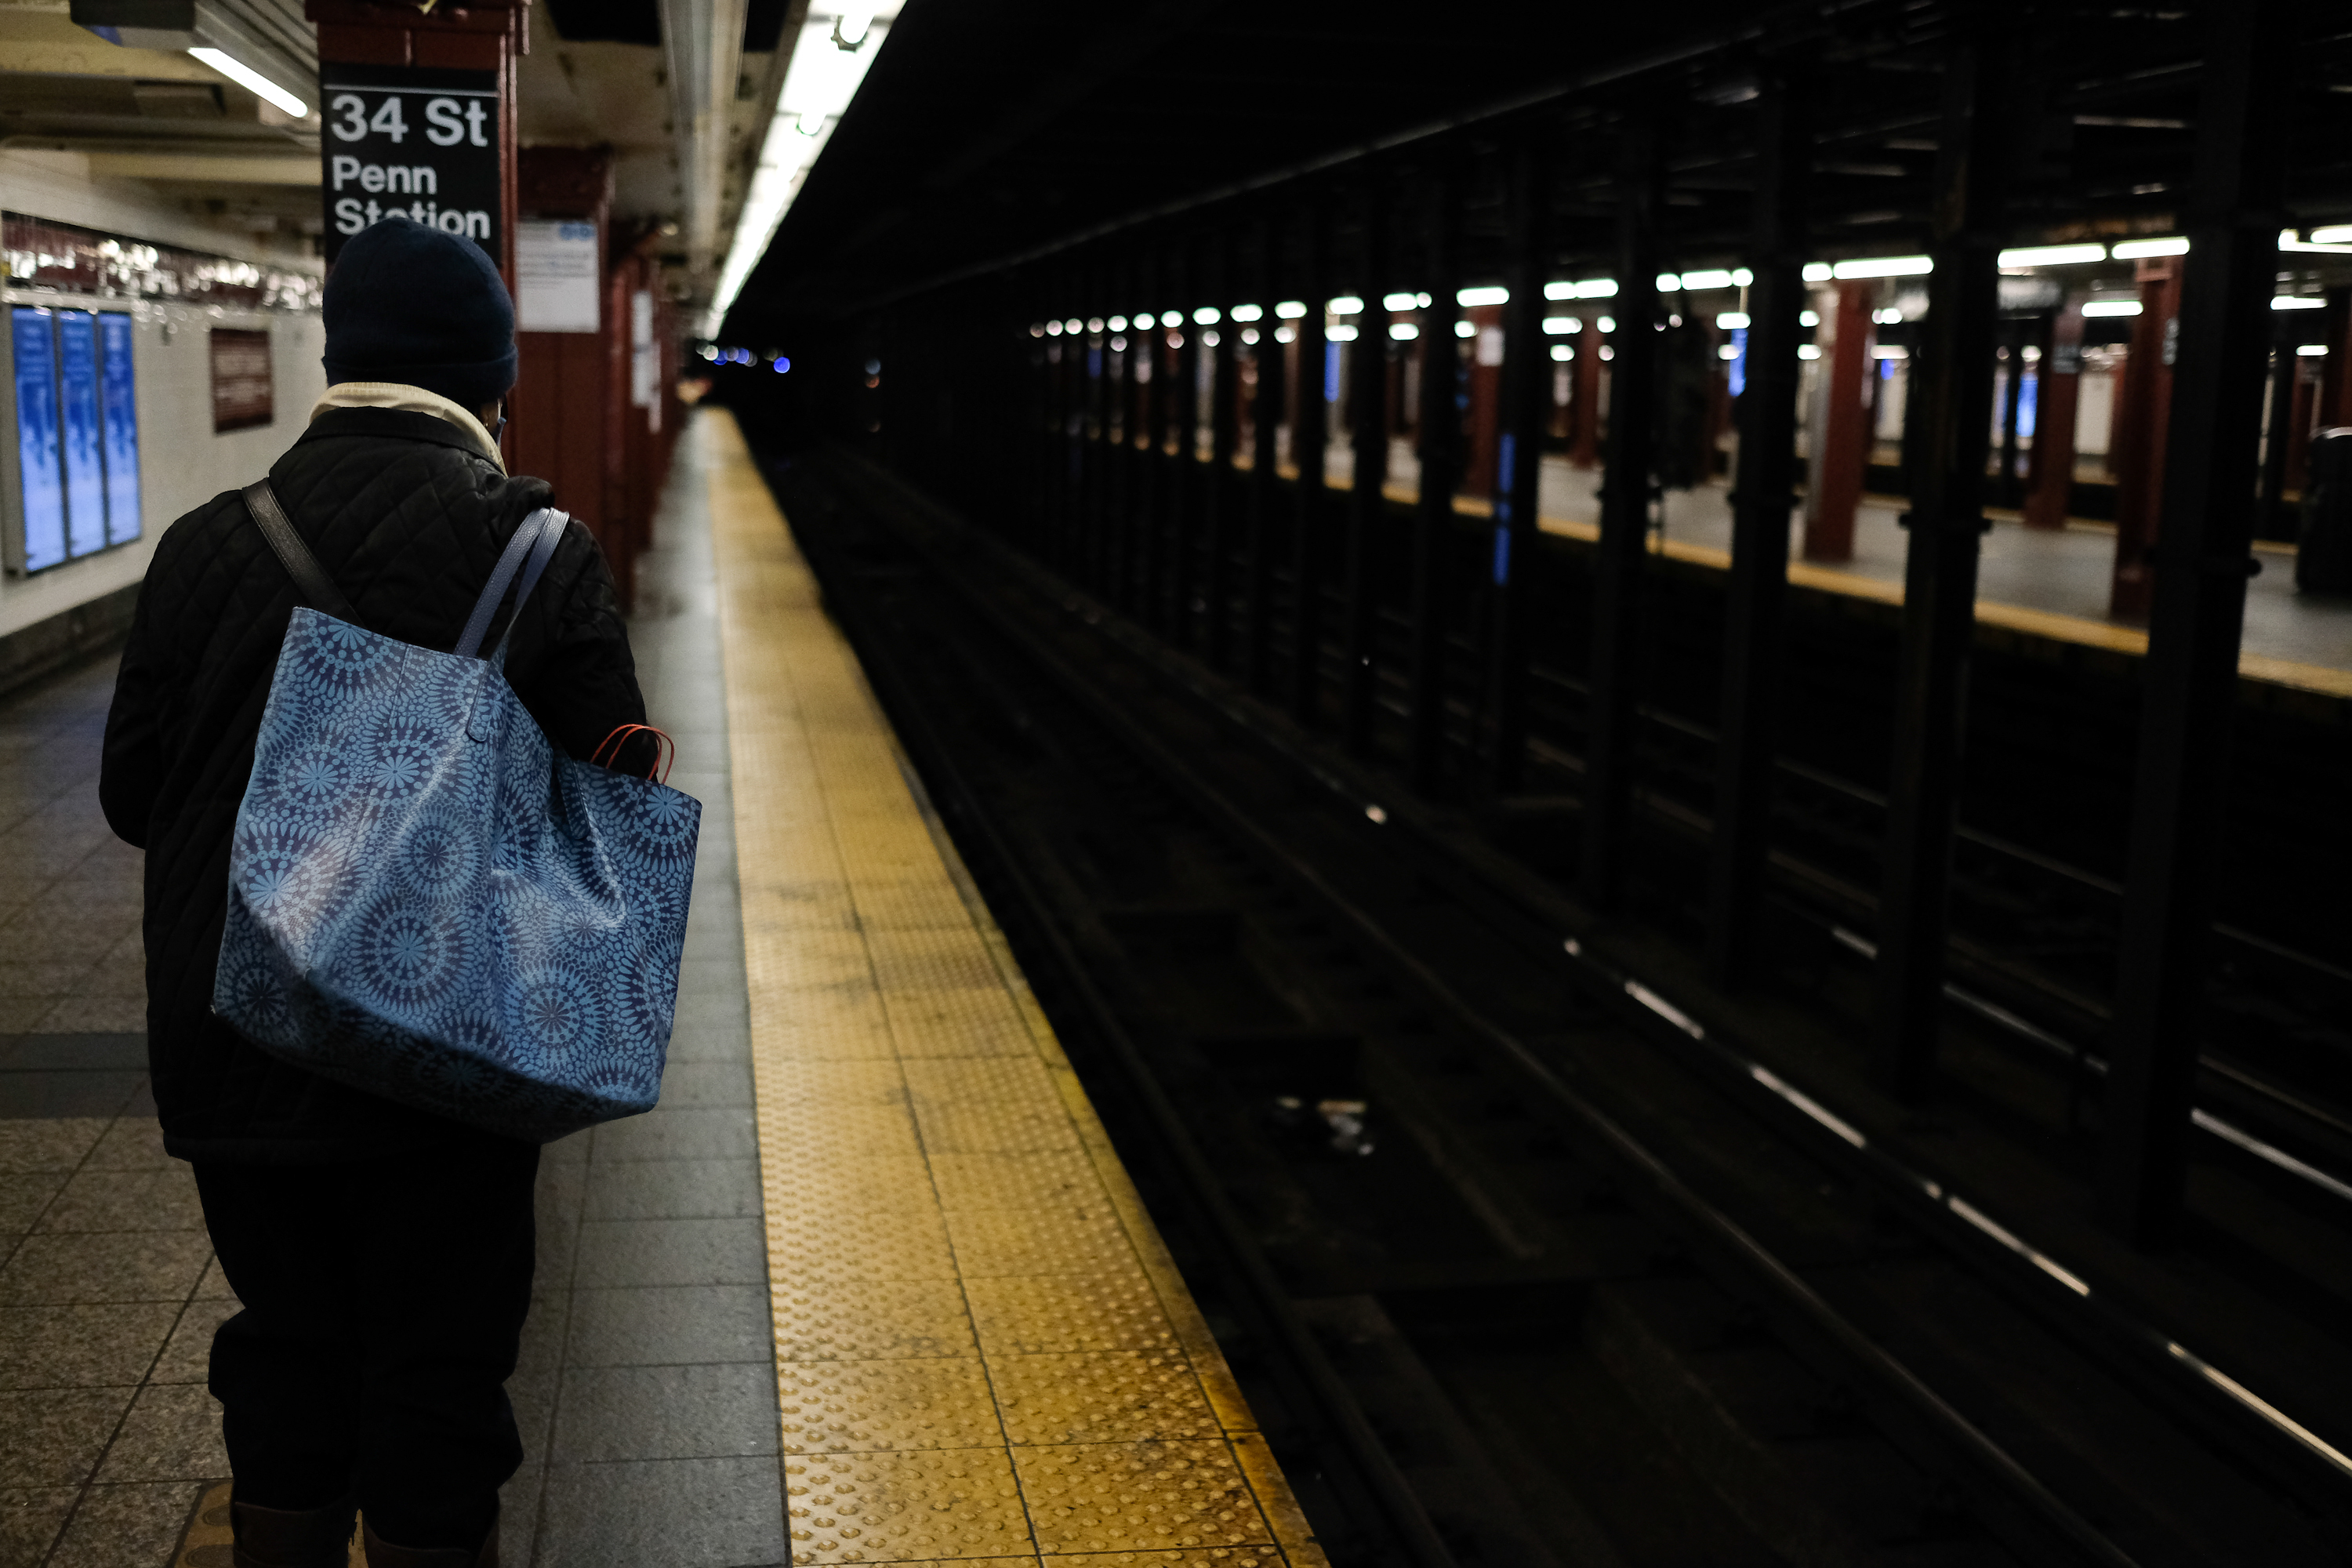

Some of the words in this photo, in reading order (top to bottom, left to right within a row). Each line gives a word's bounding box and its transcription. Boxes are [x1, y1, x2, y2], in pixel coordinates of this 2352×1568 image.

[331, 95, 408, 143] 34
[426, 98, 488, 147] St
[332, 155, 437, 194] Penn
